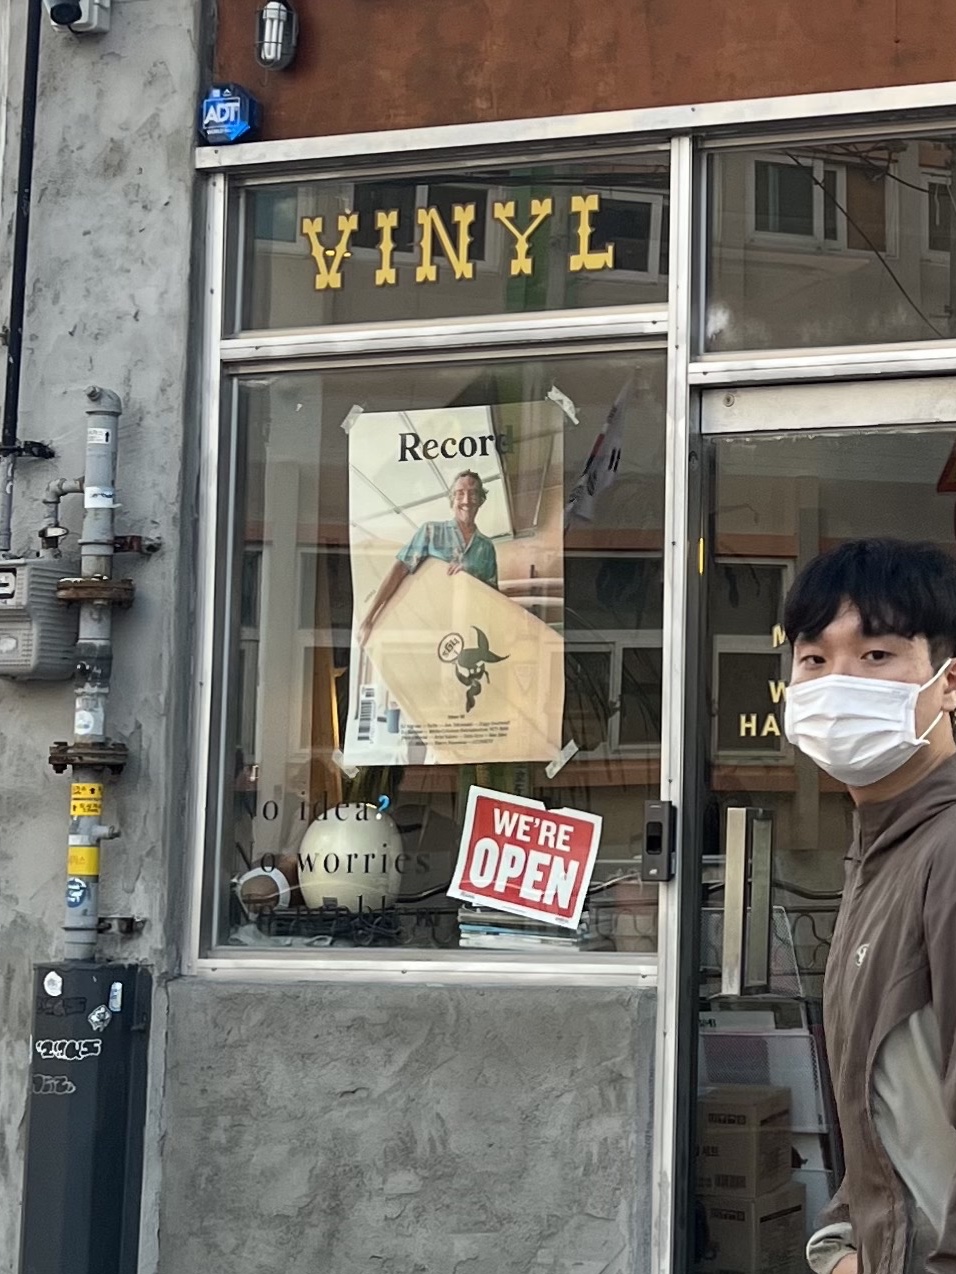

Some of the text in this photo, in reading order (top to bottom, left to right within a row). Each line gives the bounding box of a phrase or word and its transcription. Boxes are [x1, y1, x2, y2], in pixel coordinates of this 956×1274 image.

[203, 102, 239, 124] ADT
[301, 194, 616, 291] VINYL
[493, 807, 574, 853] WE'RE
[297, 843, 431, 874] worries
[469, 837, 580, 910] OPEN
